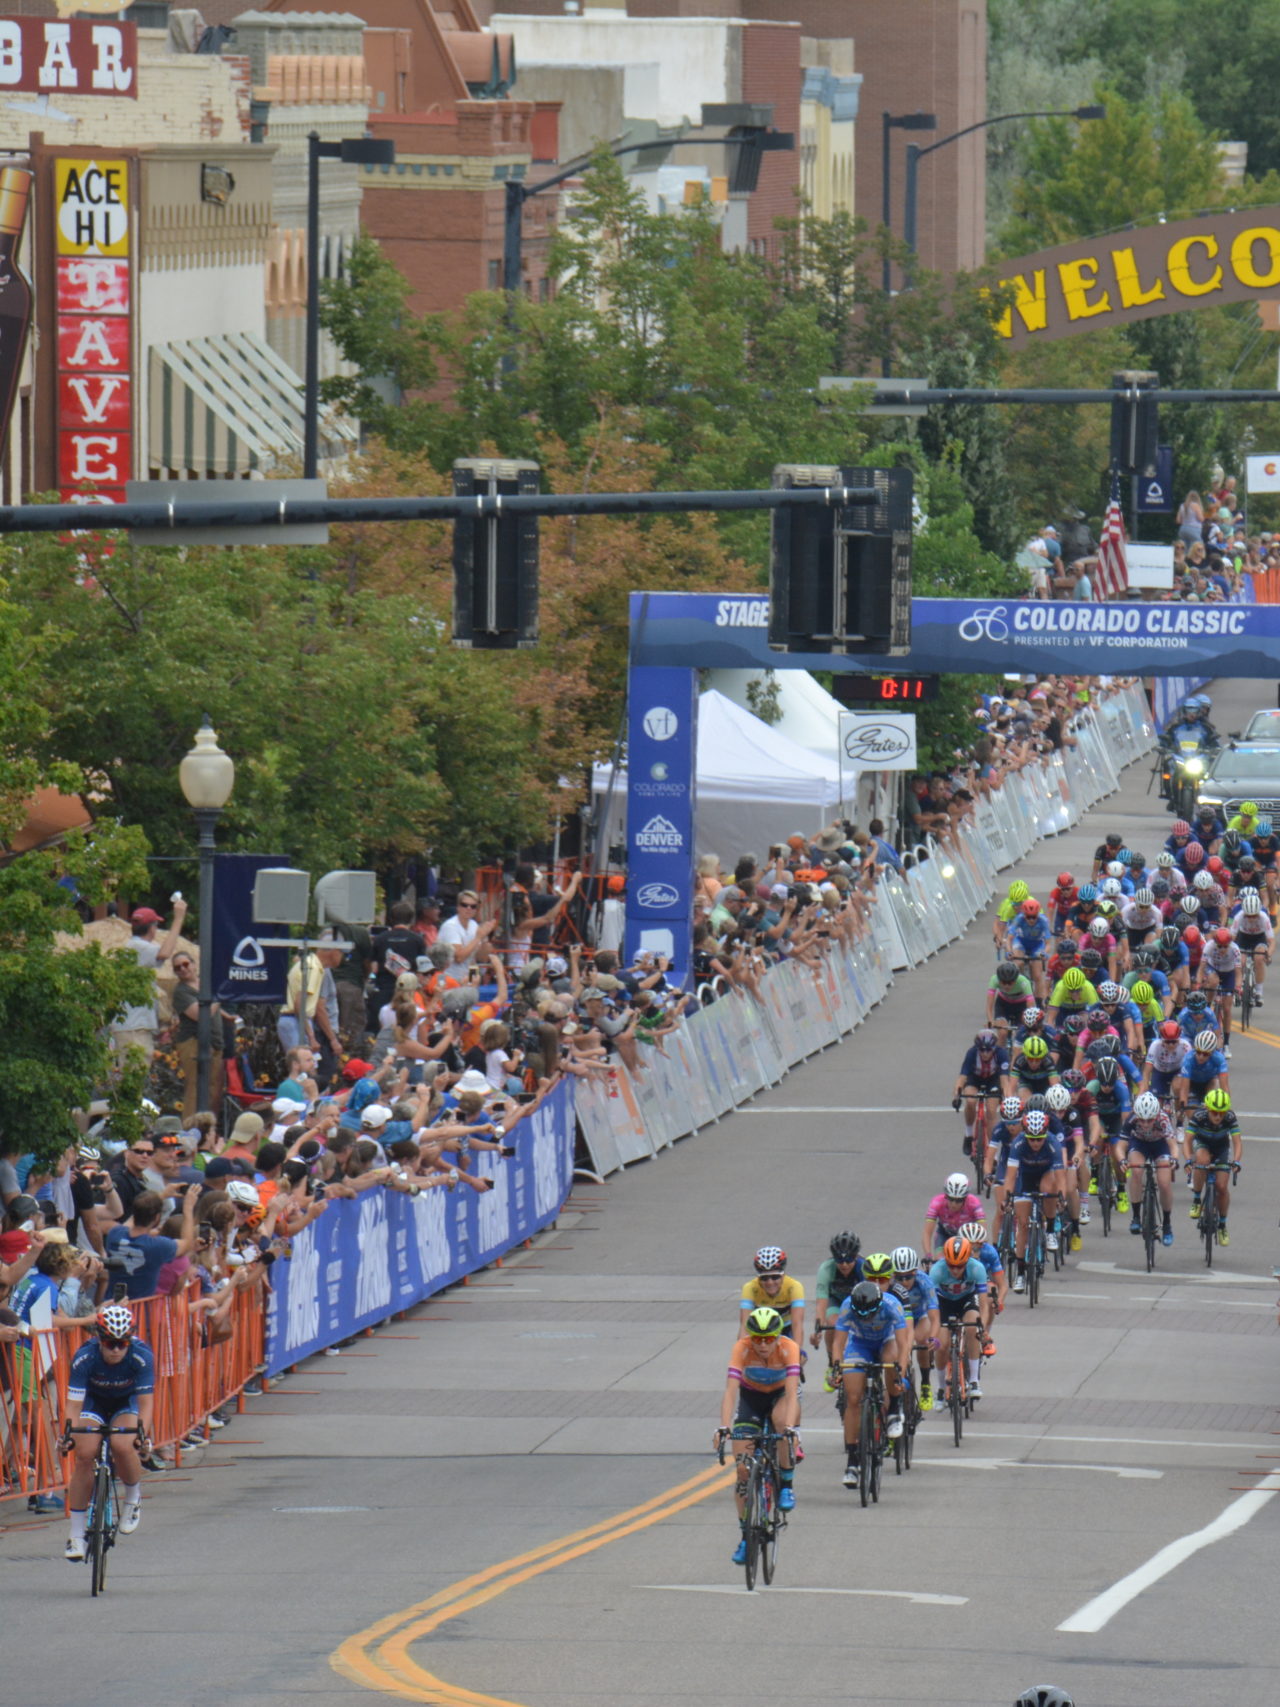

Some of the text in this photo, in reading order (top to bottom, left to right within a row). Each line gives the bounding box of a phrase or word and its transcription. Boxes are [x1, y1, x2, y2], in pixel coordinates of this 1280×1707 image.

[0, 22, 133, 91] BAR
[62, 168, 121, 204] ACE
[76, 210, 111, 247] HI
[66, 262, 120, 505] TAVE
[716, 600, 768, 627] STAGE
[1014, 607, 1246, 635] COLORADO CLASSIC
[1014, 636, 1188, 648] PRESENTED BY VF CORPORATION
[881, 679, 923, 698] 0:11
[848, 728, 909, 758] Gates
[635, 833, 683, 846] DENVER
[228, 969, 268, 980] MINES
